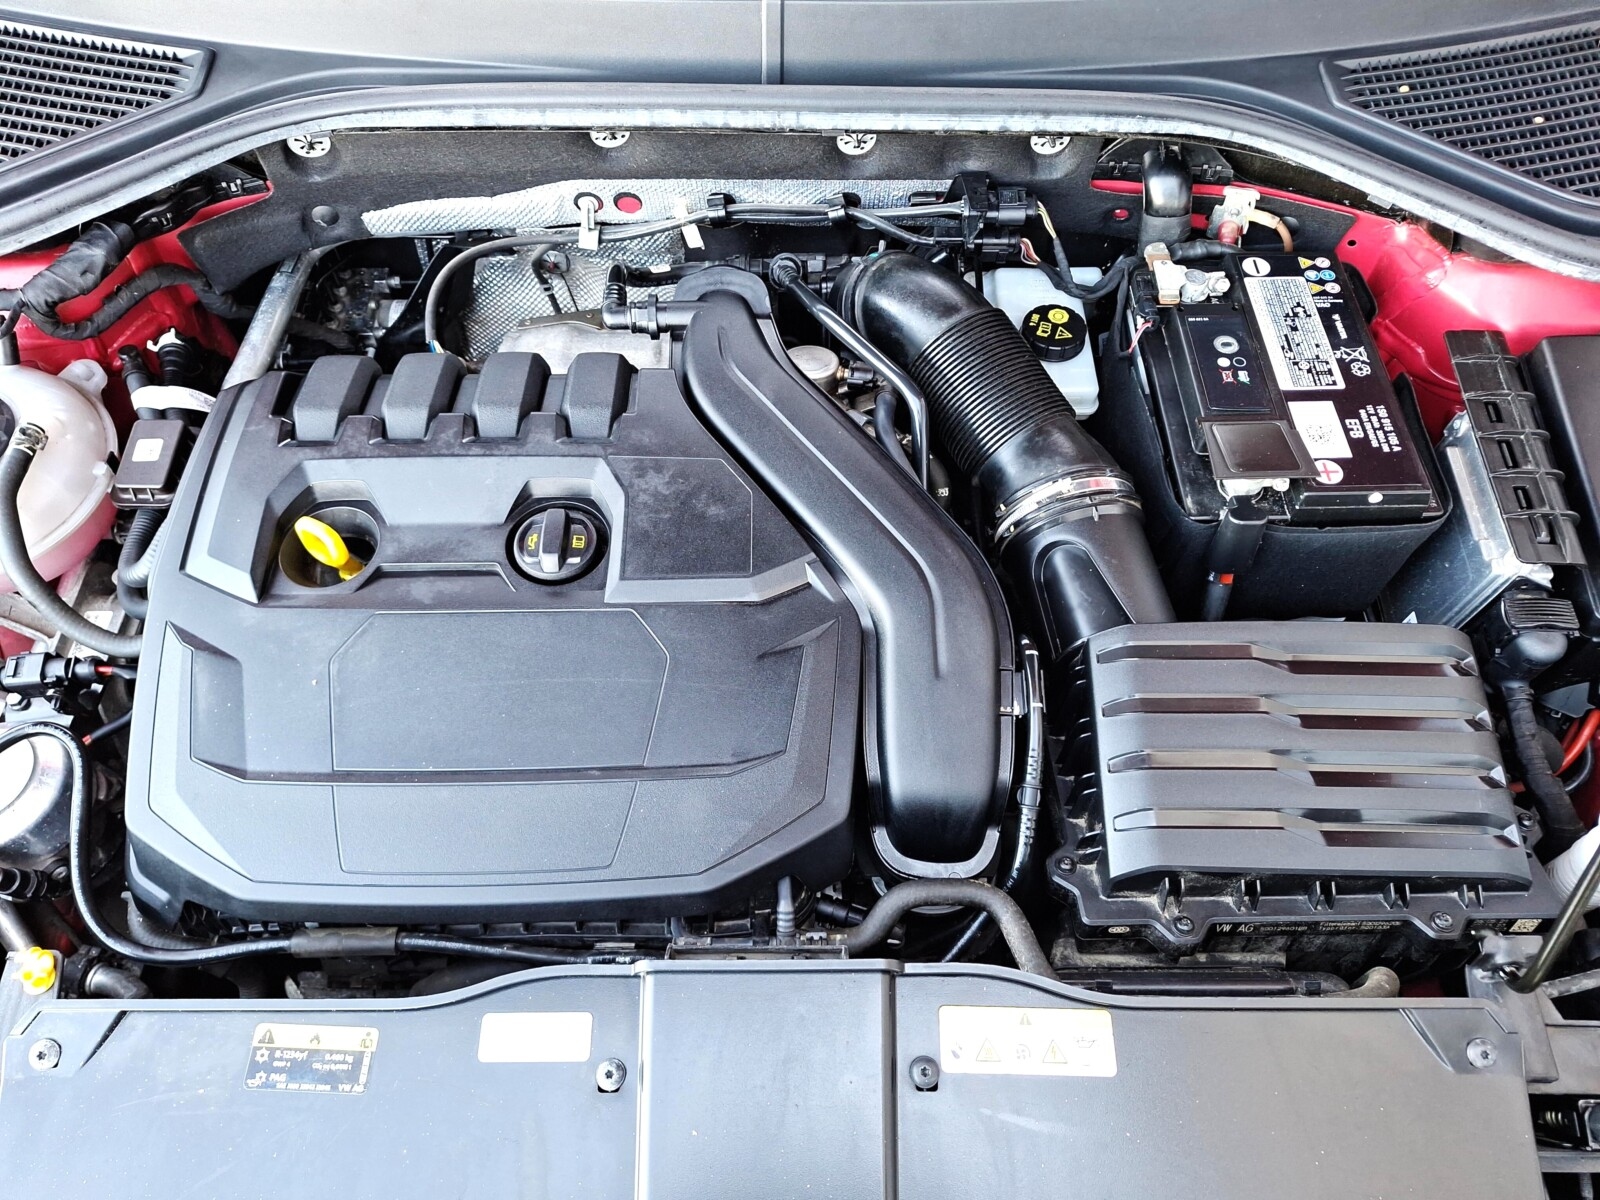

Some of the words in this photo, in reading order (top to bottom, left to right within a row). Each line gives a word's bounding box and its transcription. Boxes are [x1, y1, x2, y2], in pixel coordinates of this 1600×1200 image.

[1344, 418, 1365, 439] EFB
[1216, 924, 1233, 933] VW
[1236, 923, 1255, 933] AG
[268, 1072, 287, 1082] PAG
